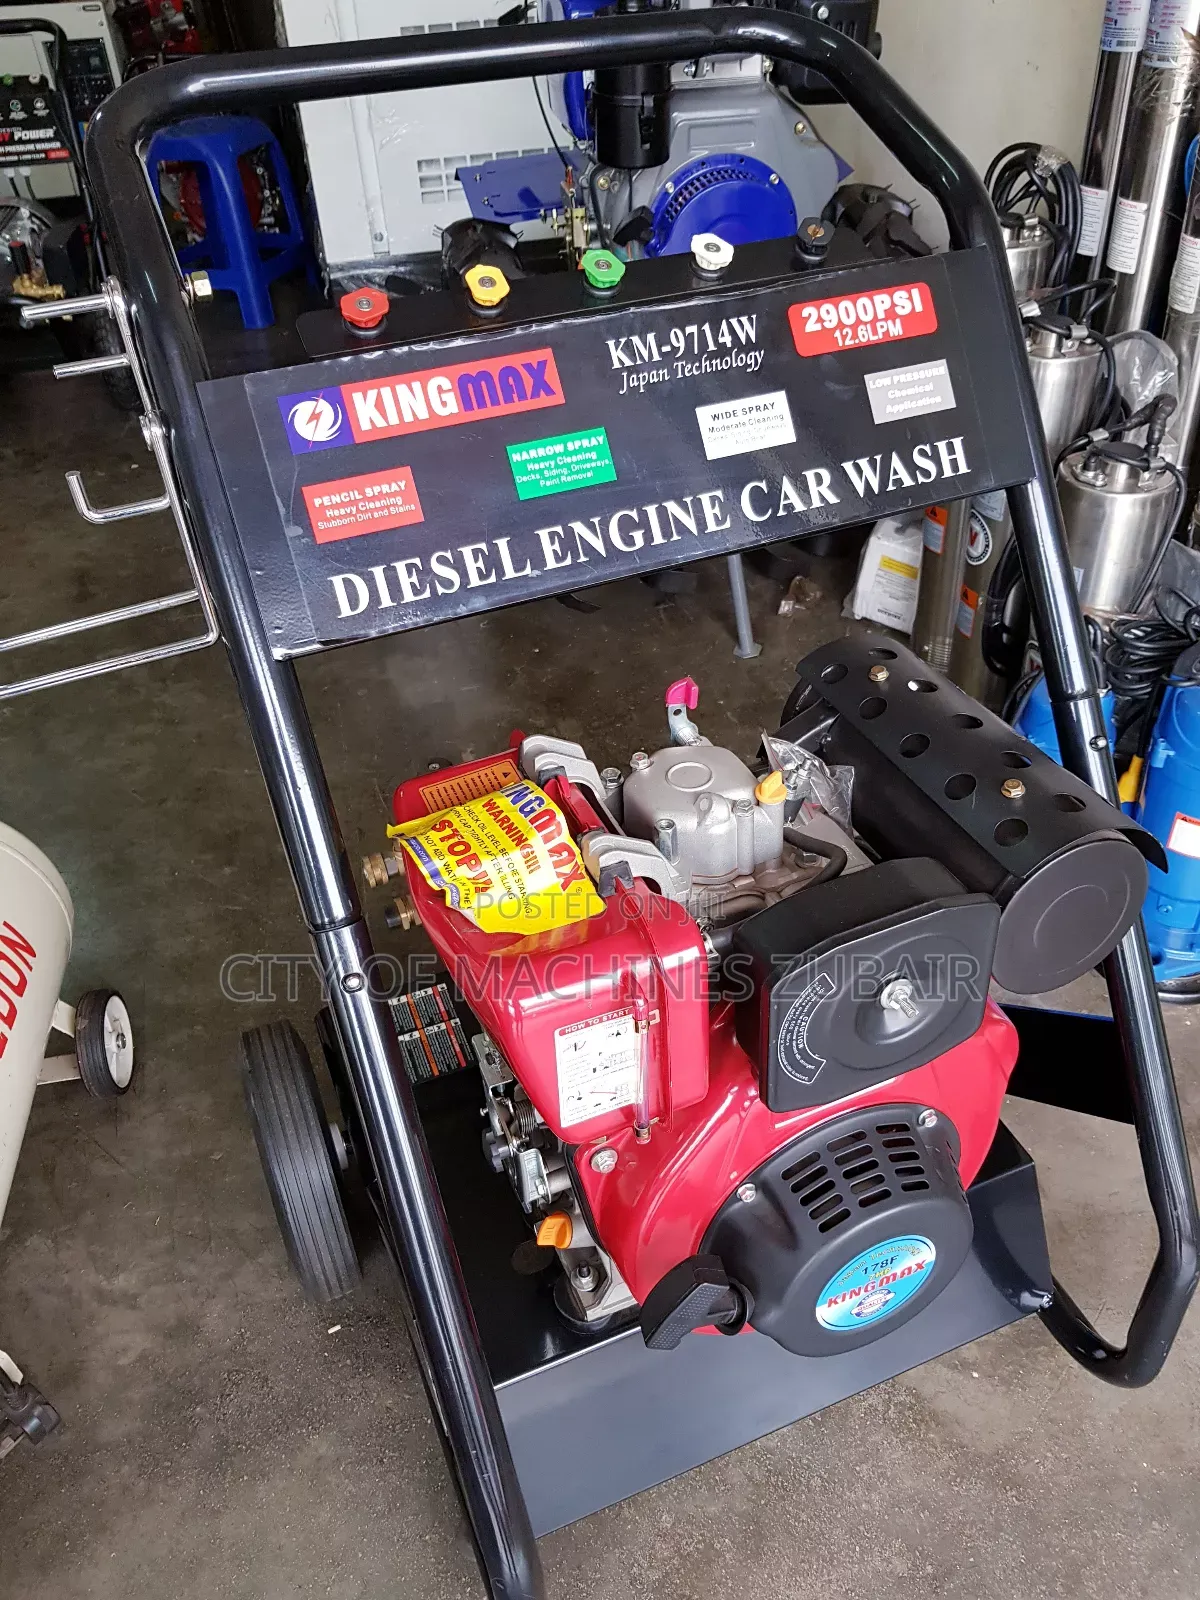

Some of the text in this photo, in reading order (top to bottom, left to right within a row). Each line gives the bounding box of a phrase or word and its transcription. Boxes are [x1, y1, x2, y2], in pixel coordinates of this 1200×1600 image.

[14, 129, 54, 141] POWER
[802, 288, 923, 333] 2900PSI
[605, 314, 757, 369] KM-9714W
[833, 318, 903, 347] 12.6LPM
[619, 348, 764, 395] Japan Technology
[869, 366, 945, 389] LOW PRESSURE
[887, 382, 934, 399] Chemical
[711, 402, 775, 421] WIDE SPRAY
[885, 396, 942, 413] Application
[708, 421, 746, 433] Moderate
[748, 413, 784, 426] Cleaning
[512, 435, 604, 462] NARROW SPRAY
[527, 451, 597, 471] Heavy Cleaning
[540, 471, 594, 487] Paint Removal
[313, 480, 406, 508] PENCIL SPRAY
[317, 503, 416, 530] Stubborn Dirt and Stains
[325, 496, 403, 518] Heavy Cleaning
[327, 436, 972, 619] DIESEL ENGINE CAR WASH
[463, 805, 481, 826] CHECK
[485, 831, 502, 849] LEVEL
[482, 798, 541, 874] WARNING!!!
[565, 1009, 630, 1033] HOW TO START
[797, 1016, 809, 1049] CAUTION
[861, 1254, 899, 1275] 178F
